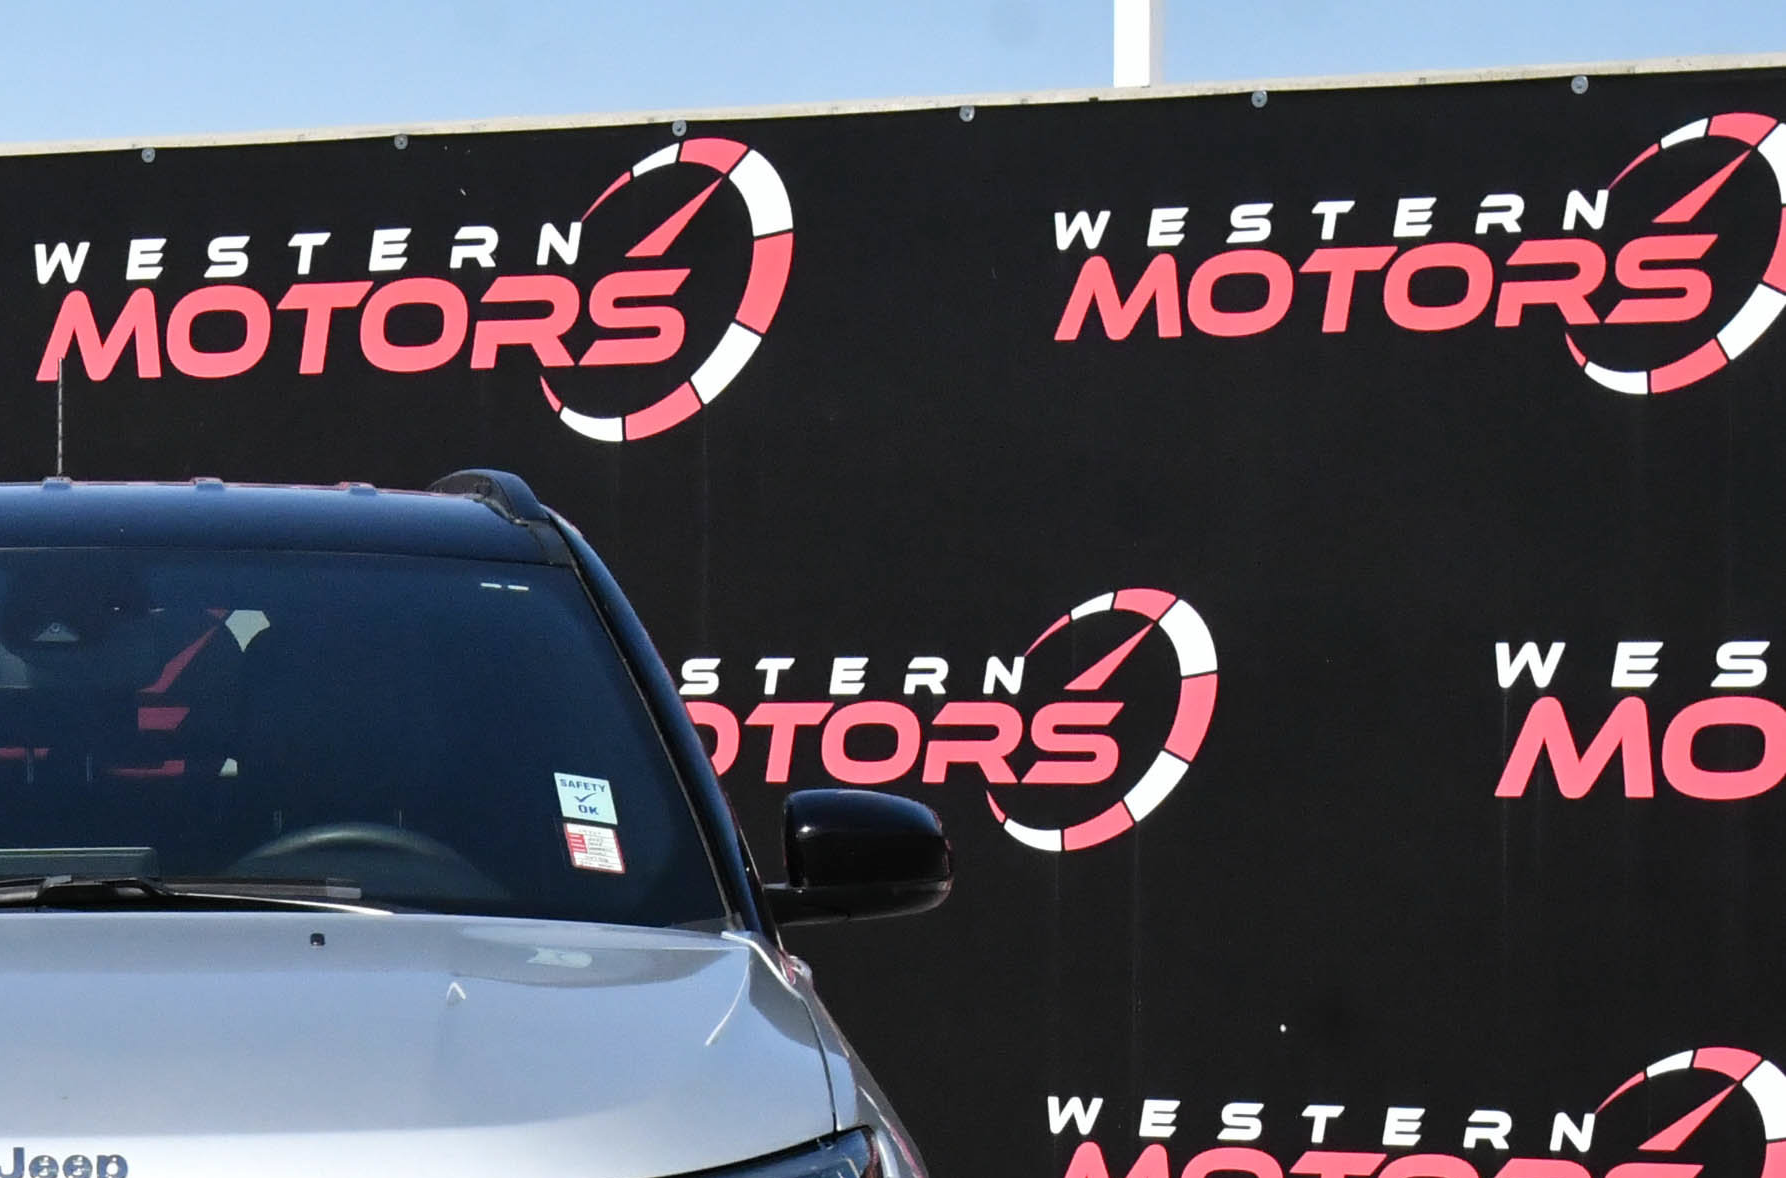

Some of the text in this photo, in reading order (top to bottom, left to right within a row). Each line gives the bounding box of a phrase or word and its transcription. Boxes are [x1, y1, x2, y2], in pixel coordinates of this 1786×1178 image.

[1055, 190, 1610, 250] WESTERN
[35, 221, 583, 285] WESTERN
[1053, 233, 1718, 341] MOTORS
[36, 267, 691, 382] MOTORS
[560, 779, 606, 793] SAFETY
[578, 804, 599, 815] OK
[1047, 1096, 1596, 1153] WESTERN
